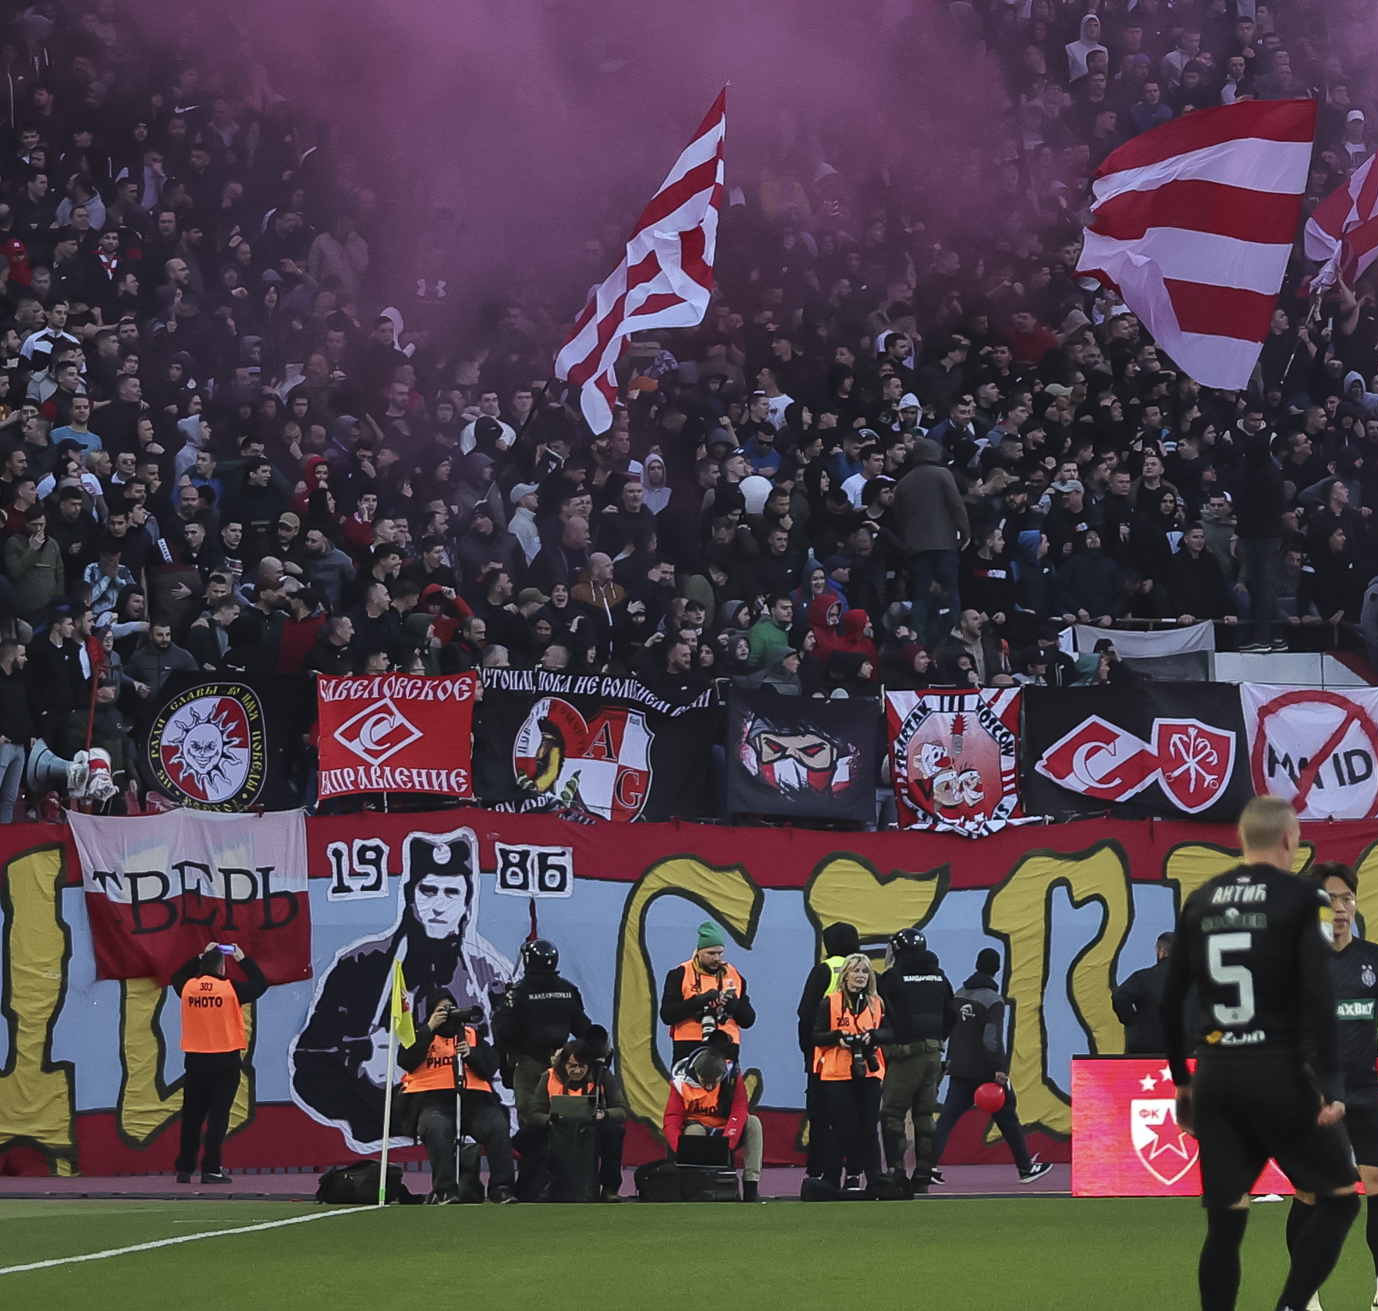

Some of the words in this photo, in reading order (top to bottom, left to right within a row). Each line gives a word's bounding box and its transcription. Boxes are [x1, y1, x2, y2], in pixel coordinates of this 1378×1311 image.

[170, 685, 218, 710] СЛАВЫ
[537, 671, 571, 692] ПОКА
[574, 675, 600, 696] НЕ
[241, 693, 259, 721] ИМЯ
[151, 718, 166, 759] РАДИ
[584, 720, 617, 761] A
[895, 699, 932, 769] SPARTAK
[246, 730, 263, 792] ПОБЕДЫ
[615, 769, 642, 808] G
[332, 843, 386, 895] 19
[500, 848, 567, 892] 86
[92, 860, 299, 935] ТВЕРЬ
[1208, 932, 1255, 1025] 5
[189, 996, 223, 1009] PHOTO
[1336, 1000, 1375, 1016] AXBET
